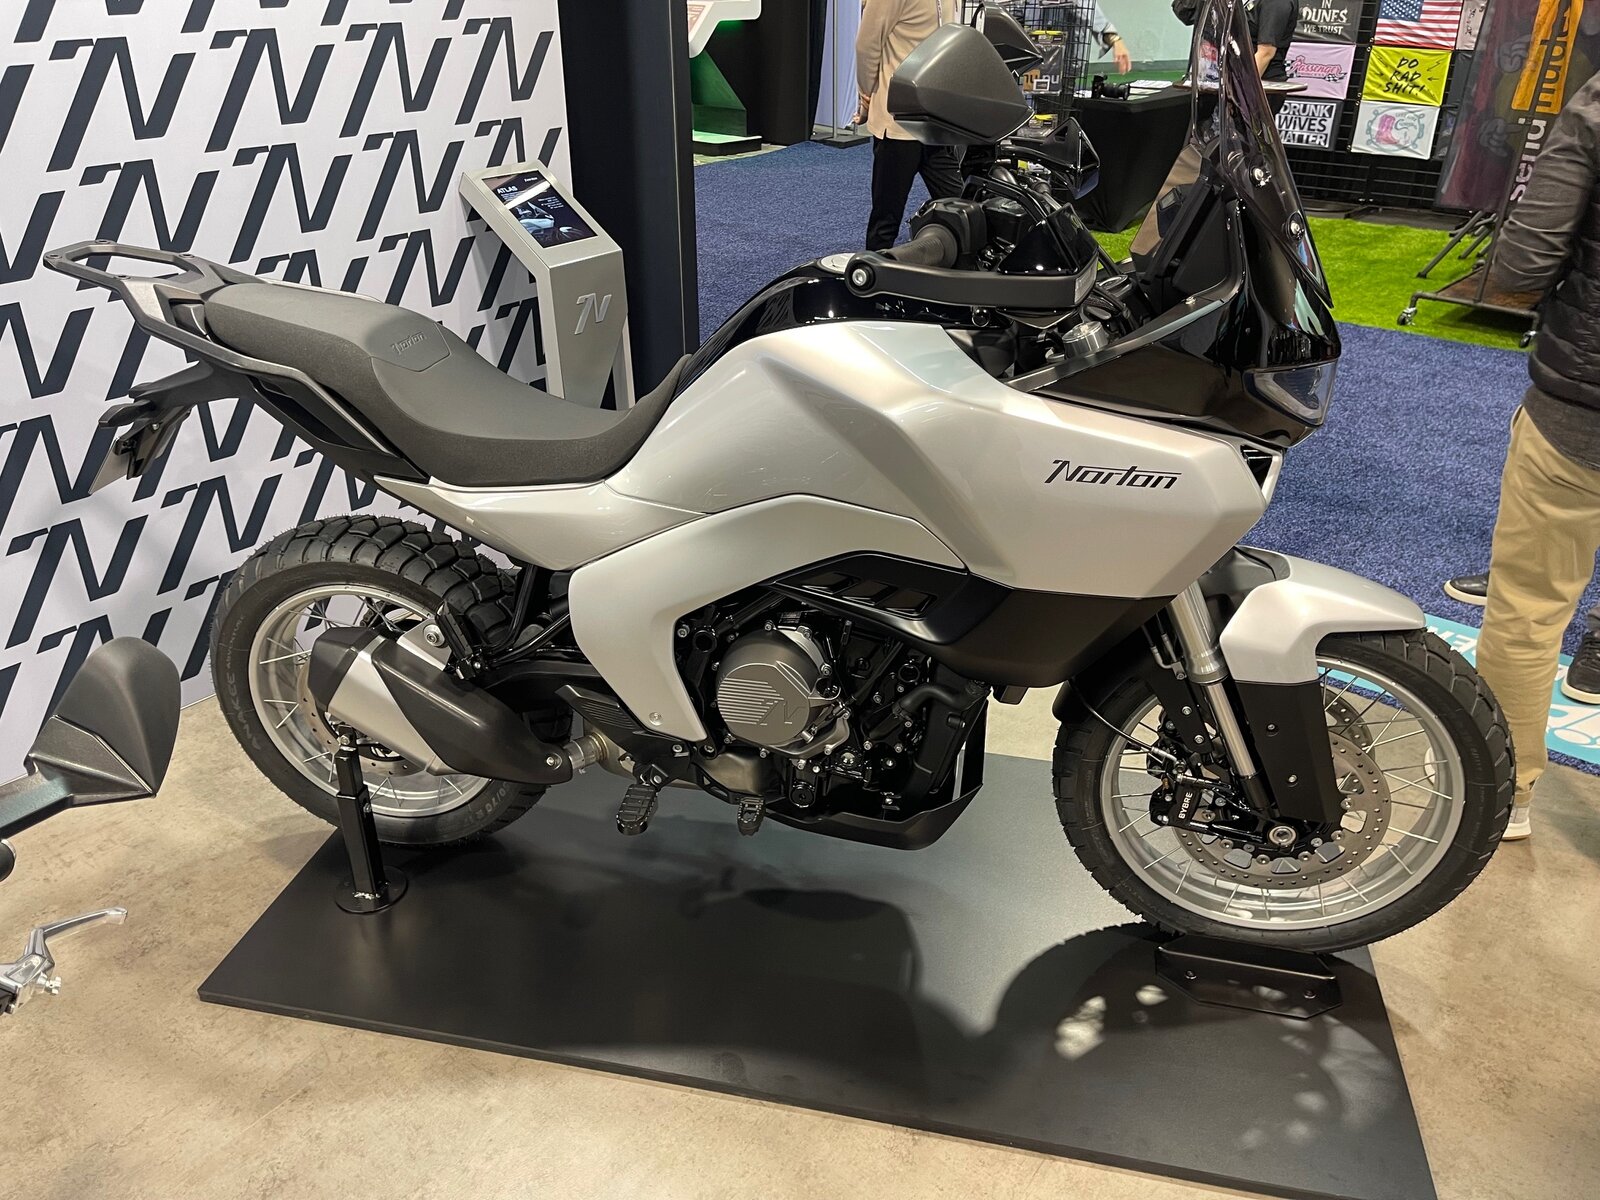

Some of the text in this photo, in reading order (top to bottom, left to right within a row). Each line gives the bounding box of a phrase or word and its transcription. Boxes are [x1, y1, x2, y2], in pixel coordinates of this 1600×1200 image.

[1302, 6, 1348, 24] DUNES
[1303, 24, 1344, 35] WE TRUST
[1396, 57, 1419, 69] DO
[1390, 70, 1422, 82] RAD
[1383, 82, 1426, 96] SHIT!
[1280, 103, 1331, 118] DRUNK
[497, 185, 518, 194] ATLAS
[1044, 459, 1182, 489] Norton
[1178, 792, 1193, 819] BYBRE
